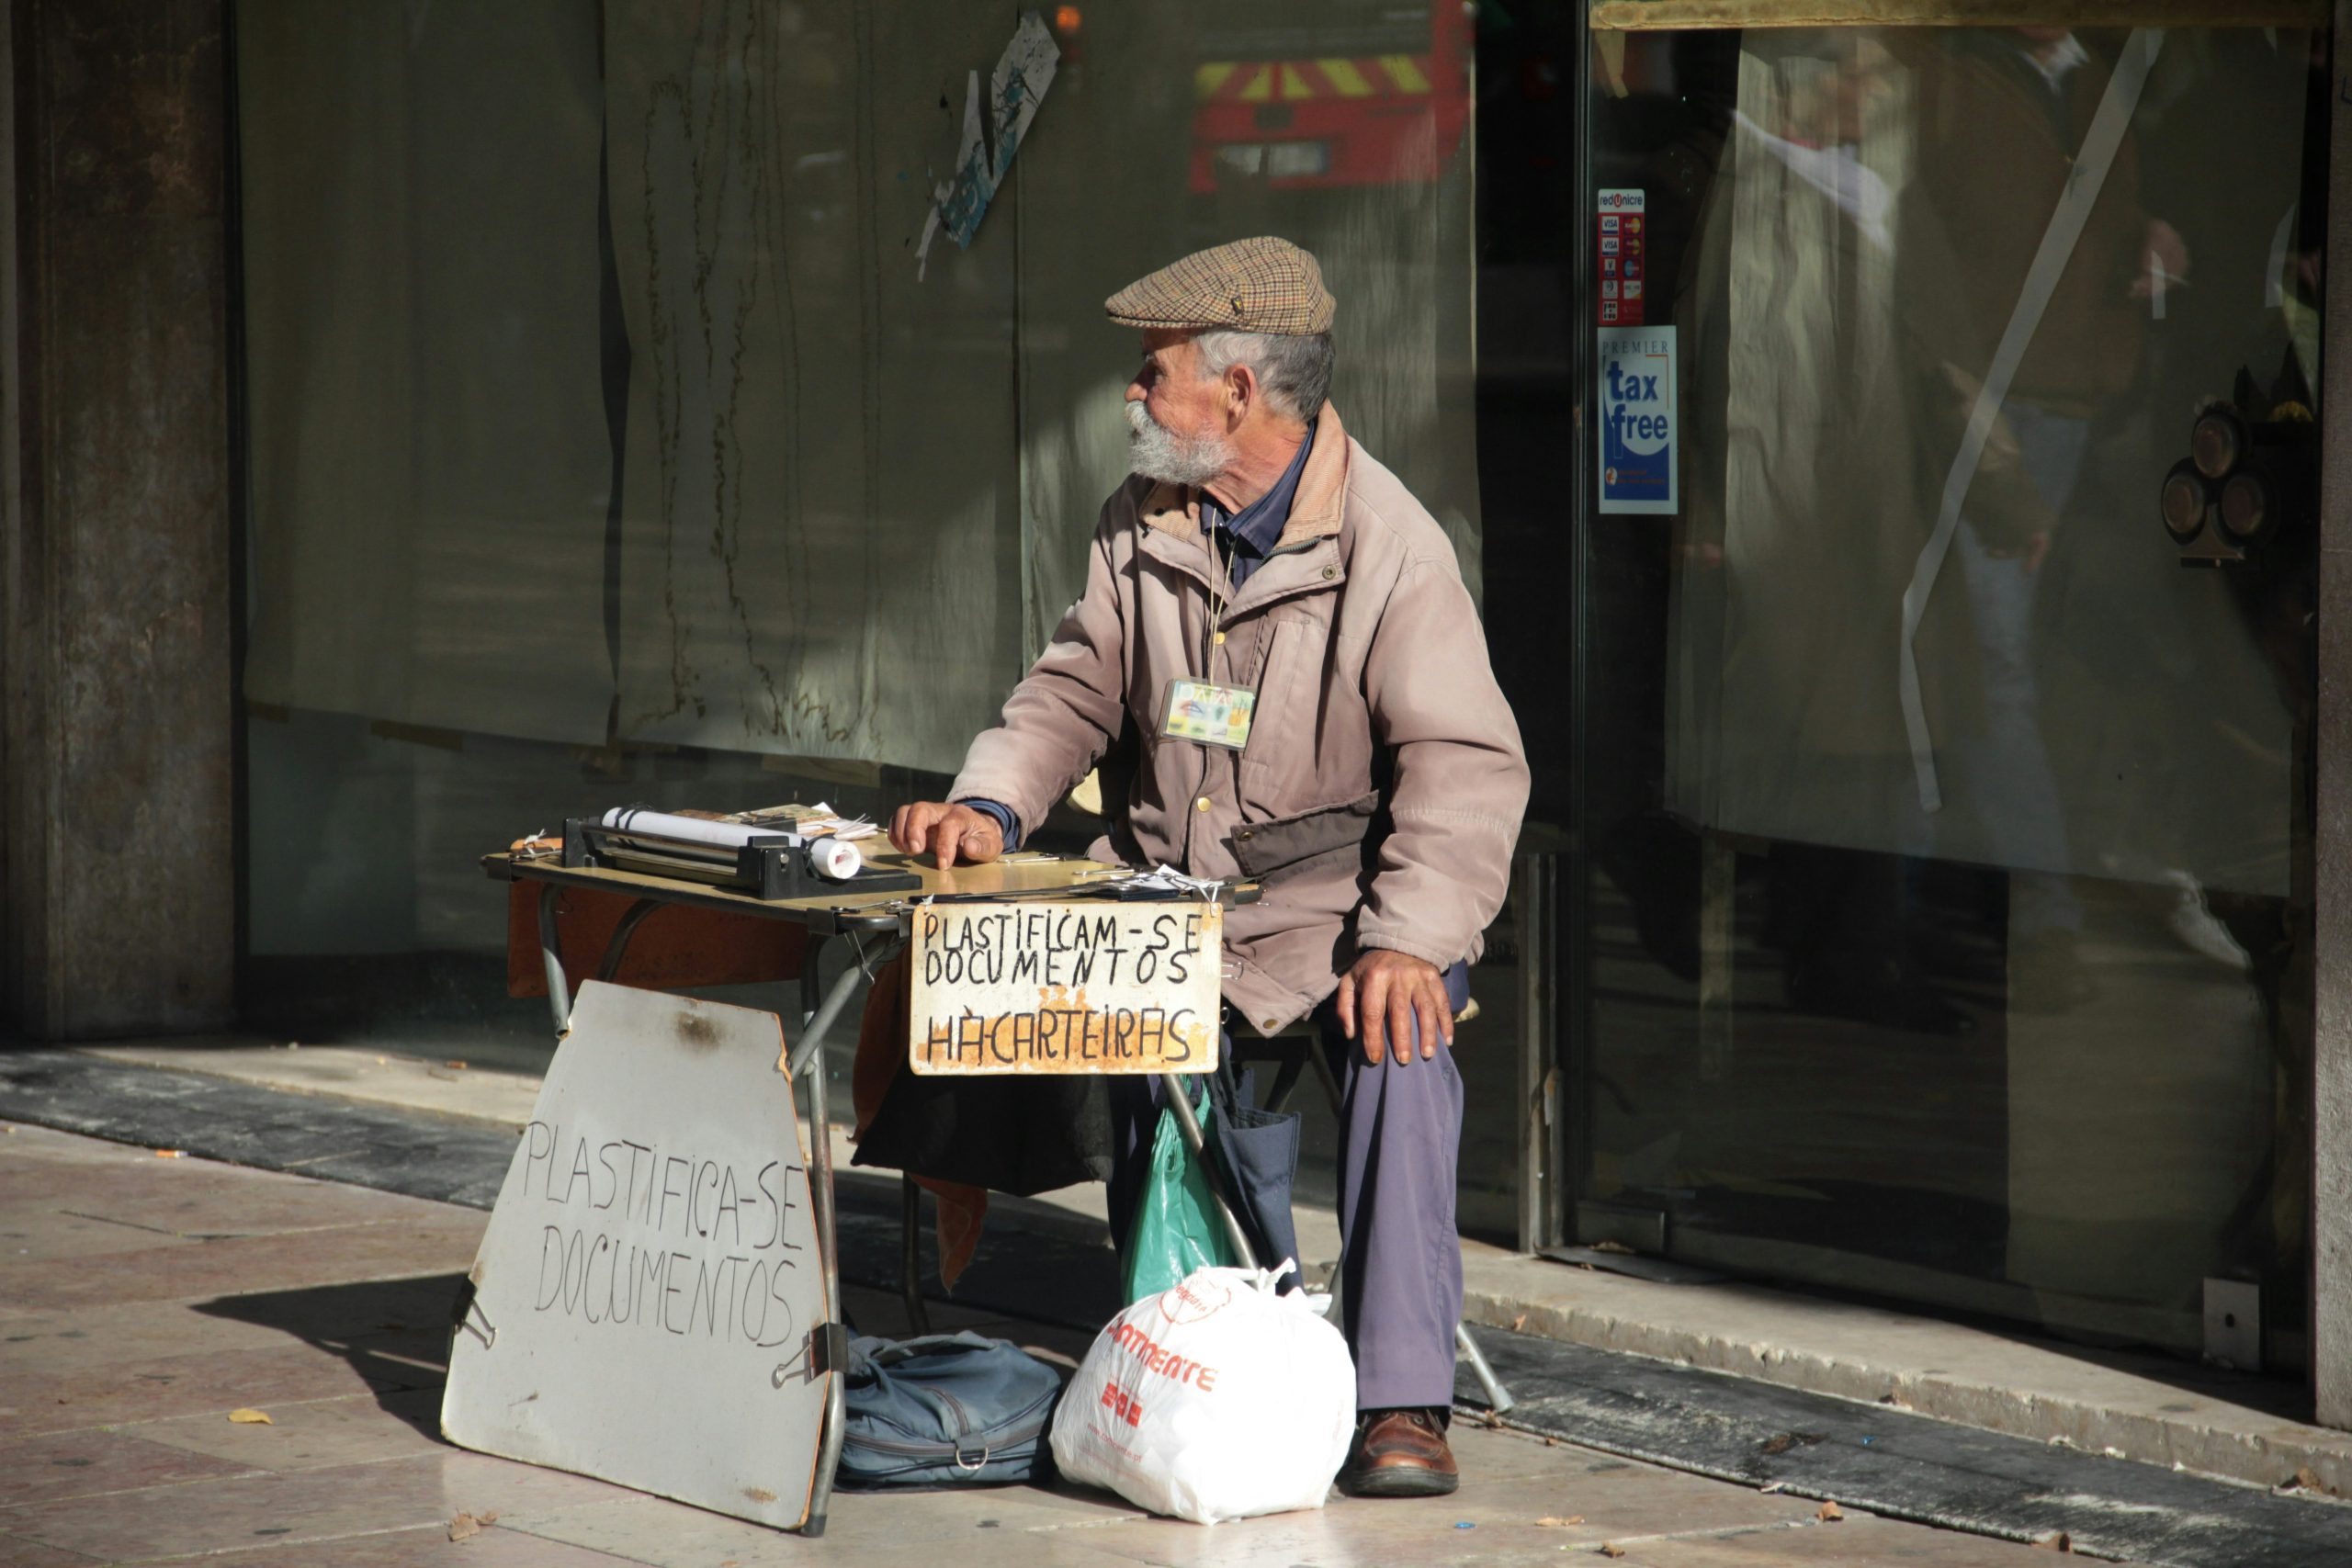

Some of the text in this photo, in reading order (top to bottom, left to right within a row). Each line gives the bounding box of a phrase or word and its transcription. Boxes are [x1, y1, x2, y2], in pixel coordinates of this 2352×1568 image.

[1604, 219, 1618, 228] VISA
[1604, 241, 1618, 249] VISA
[1602, 341, 1668, 354] PREMIER
[1607, 361, 1657, 401] tax
[1611, 403, 1668, 458] free
[925, 948, 1193, 987] DOCUMENTOS
[524, 1121, 804, 1250] PLASTIFICA-SE
[534, 1225, 797, 1348] DOCUMENTOS
